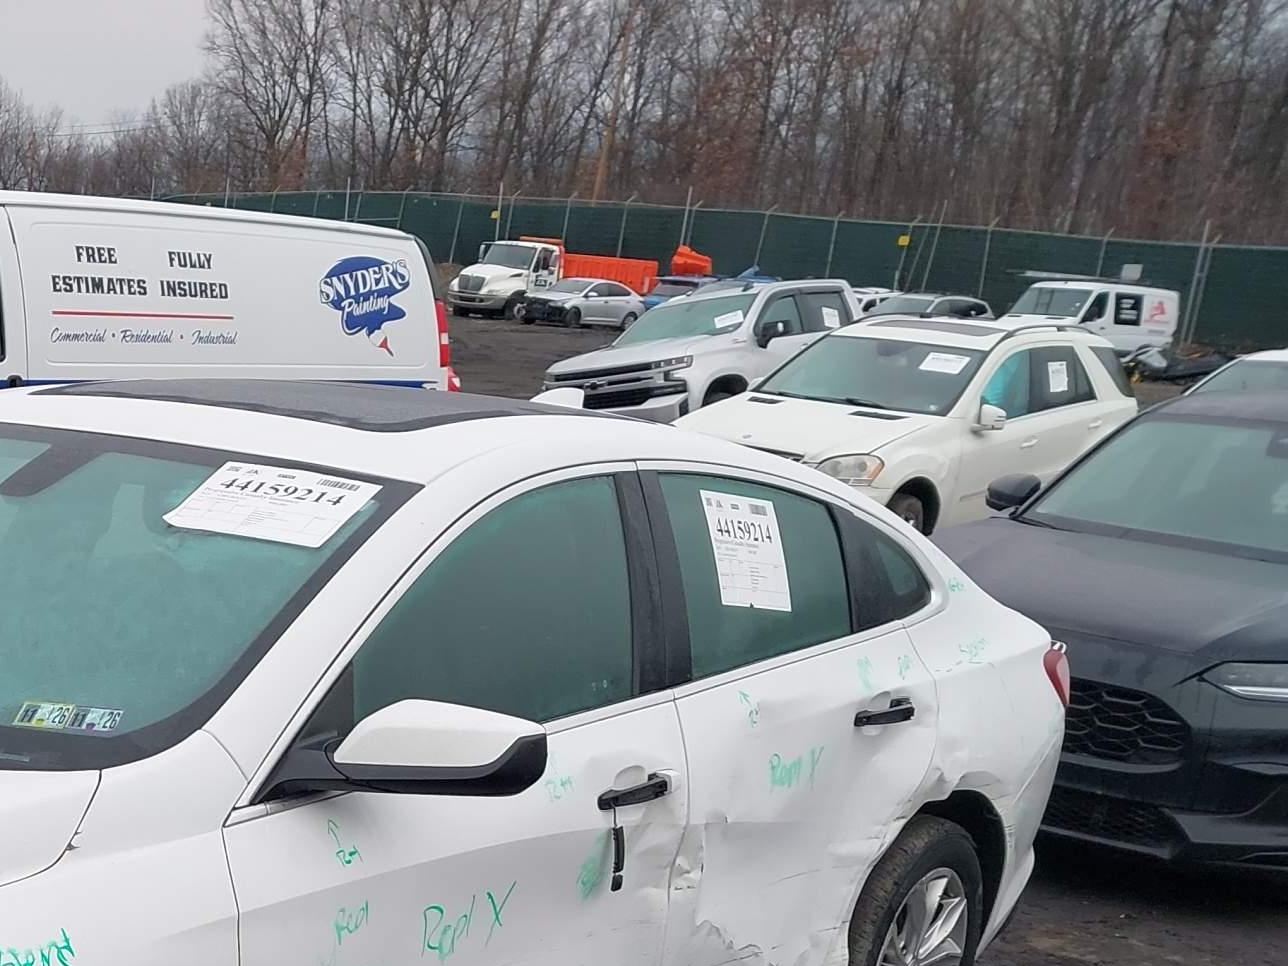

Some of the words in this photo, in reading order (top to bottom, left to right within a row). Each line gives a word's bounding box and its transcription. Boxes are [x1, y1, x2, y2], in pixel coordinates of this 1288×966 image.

[75, 245, 118, 264] FREE
[167, 250, 212, 269] FULLY
[50, 274, 148, 296] ESTIMATES
[159, 279, 229, 299] INSURED
[319, 259, 411, 304] SNYDER'S
[340, 293, 391, 316] Painting
[50, 327, 108, 344] Commercial
[120, 329, 175, 344] Residential
[191, 329, 238, 345] Industrial
[219, 477, 347, 506] 44159214
[715, 517, 773, 544] 44159214
